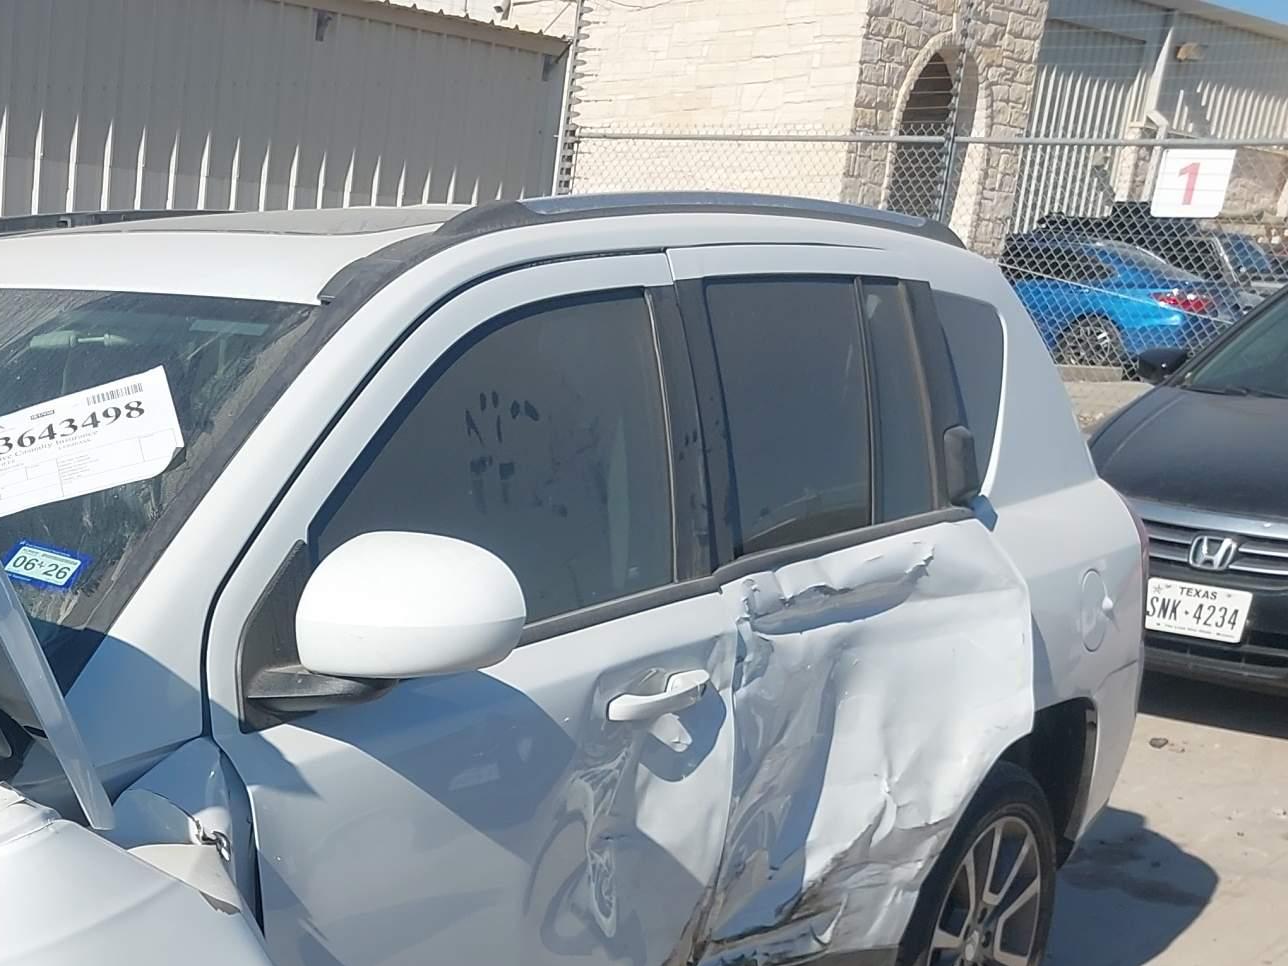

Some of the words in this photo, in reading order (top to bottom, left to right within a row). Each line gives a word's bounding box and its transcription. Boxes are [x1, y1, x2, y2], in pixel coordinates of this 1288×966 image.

[1176, 161, 1201, 206] 1
[12, 555, 39, 571] 06
[42, 563, 72, 580] 26
[1179, 586, 1218, 600] TEXAS
[1192, 603, 1239, 630] 4234
